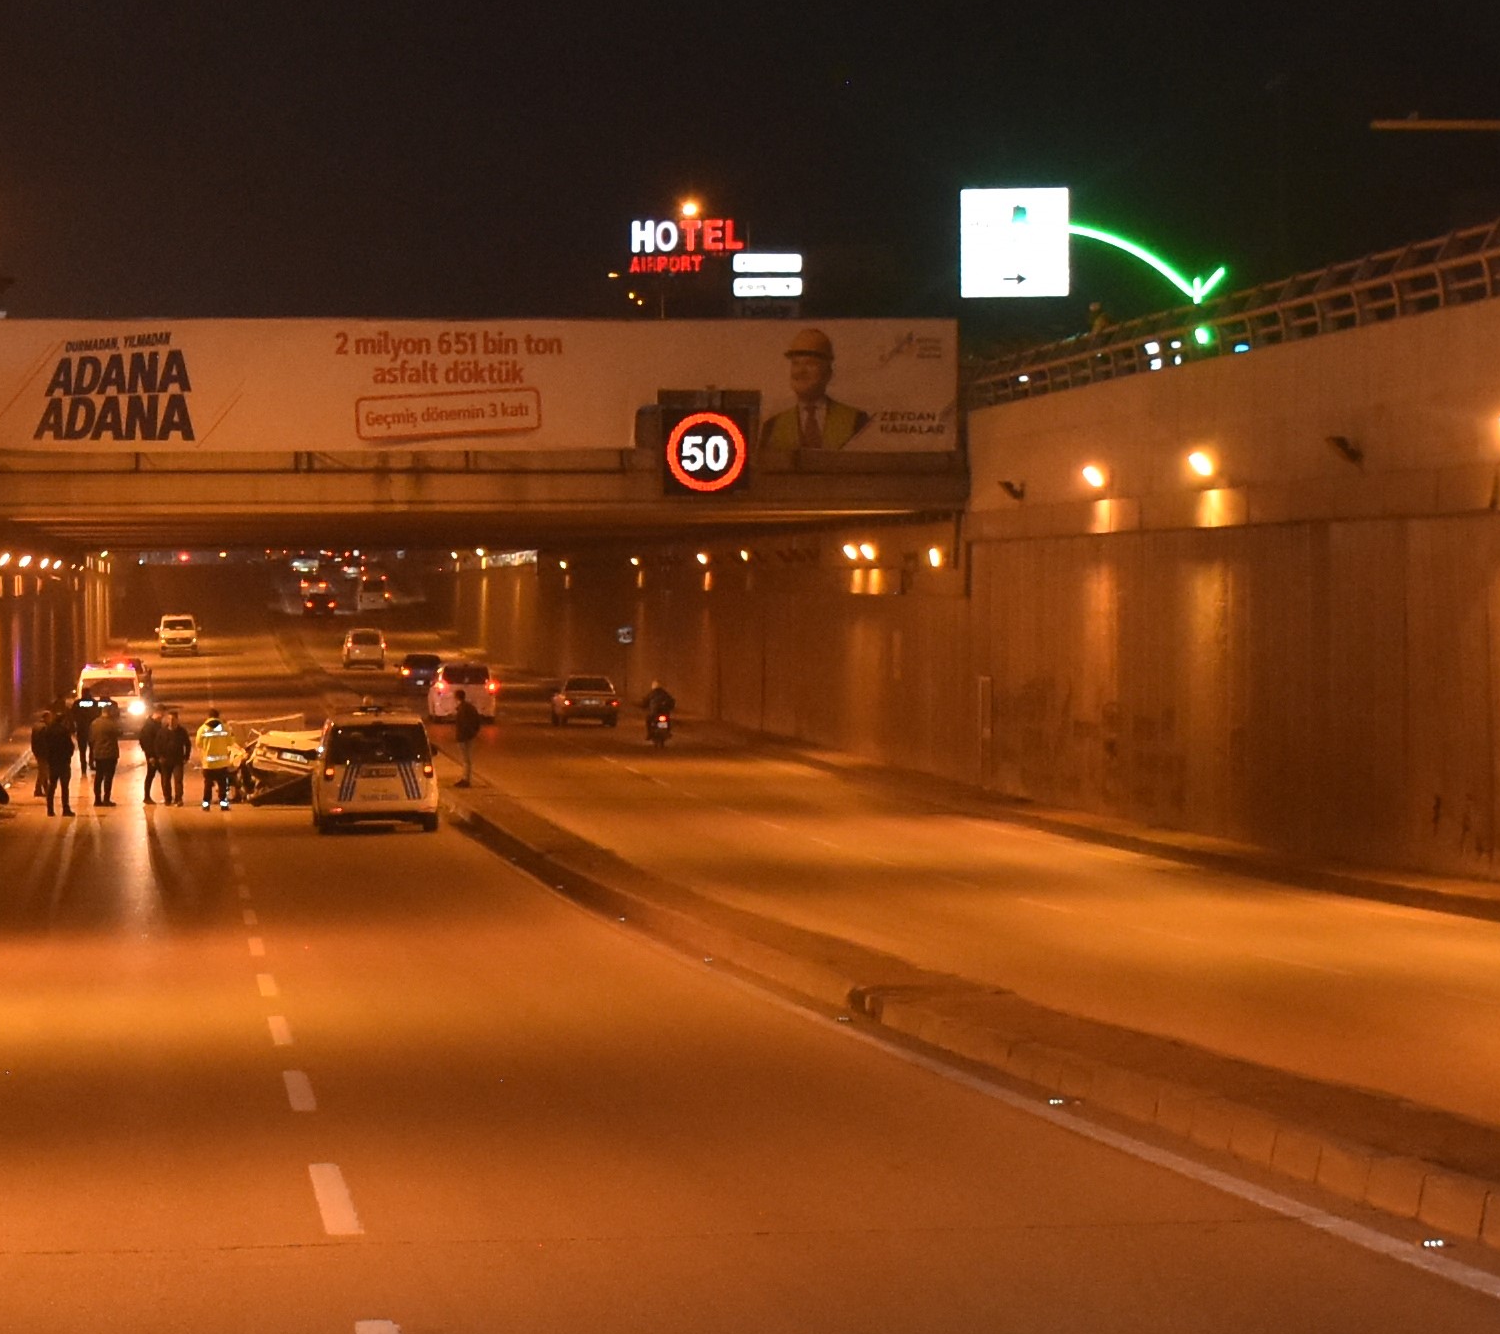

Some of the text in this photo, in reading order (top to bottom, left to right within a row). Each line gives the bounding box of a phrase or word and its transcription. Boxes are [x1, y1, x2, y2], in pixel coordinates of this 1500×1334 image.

[630, 219, 744, 253] HOTEL
[629, 255, 702, 273] AIRPORT
[335, 331, 563, 362] 2 milyon 651 bin ton
[45, 349, 192, 397] ADANA
[372, 360, 525, 384] asfalt döktük
[33, 394, 196, 441] ADANA
[366, 410, 417, 429] Geçmiş
[422, 405, 485, 422] dönemin
[490, 403, 498, 418] 3
[682, 435, 728, 471] 50
